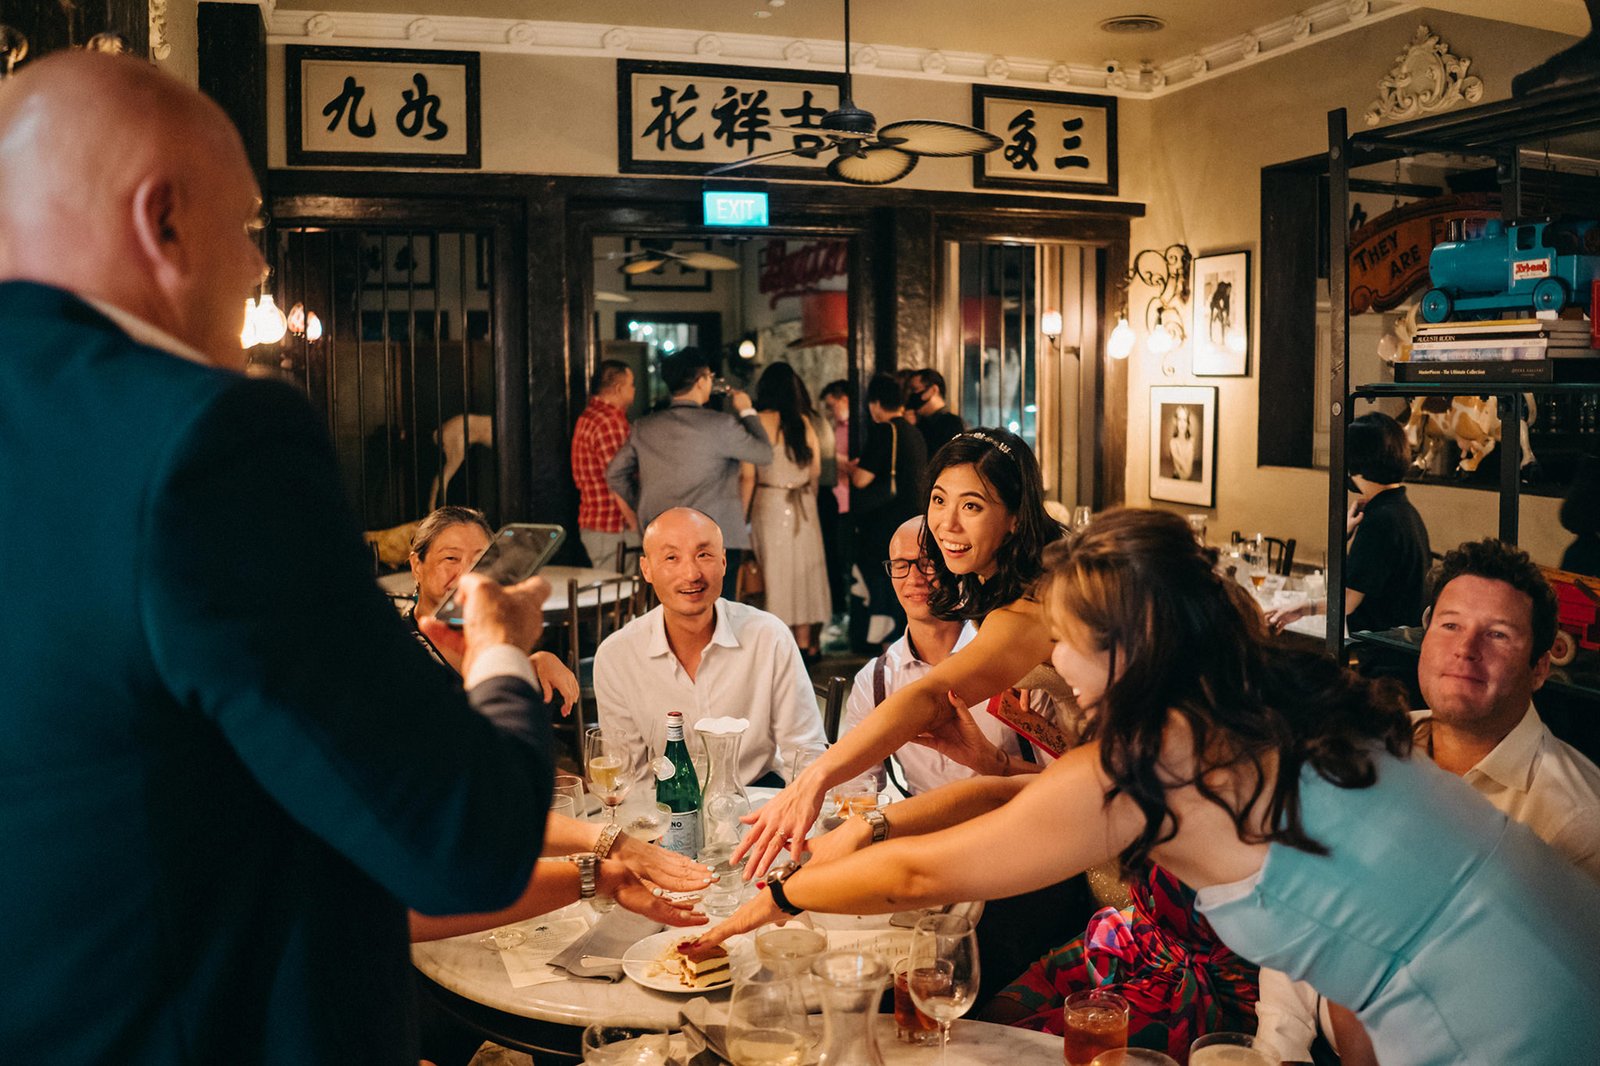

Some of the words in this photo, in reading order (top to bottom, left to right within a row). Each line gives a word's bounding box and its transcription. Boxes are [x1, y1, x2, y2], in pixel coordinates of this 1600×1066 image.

[717, 198, 755, 220] EXIT
[1353, 230, 1398, 272] THEY
[1391, 244, 1422, 278] ARE
